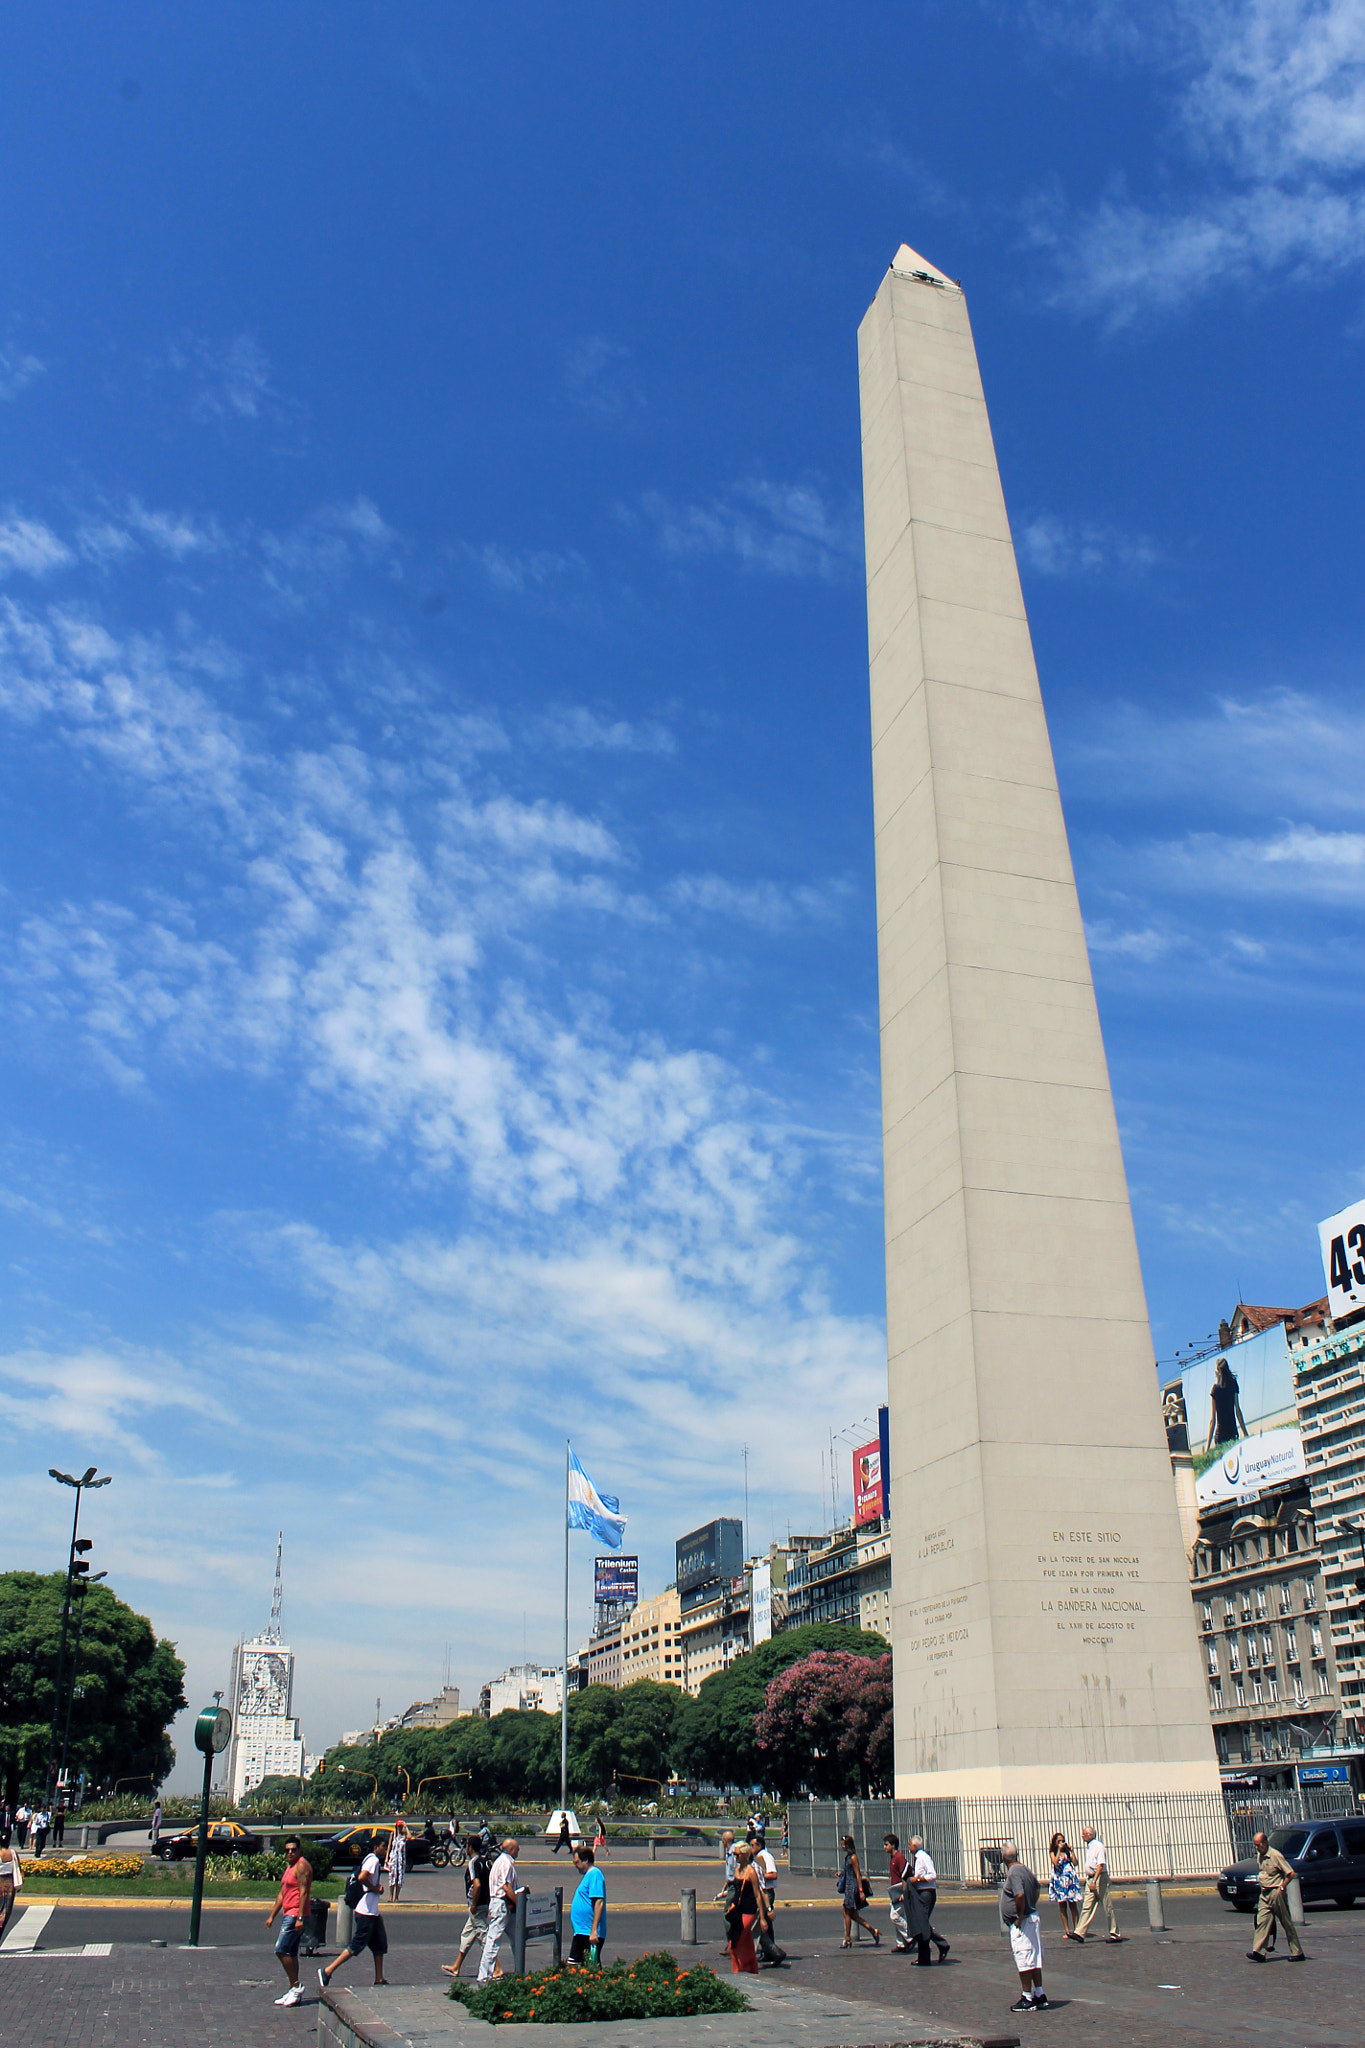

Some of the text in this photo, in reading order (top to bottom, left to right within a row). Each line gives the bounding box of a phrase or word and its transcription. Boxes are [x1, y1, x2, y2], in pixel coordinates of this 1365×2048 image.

[1053, 1532, 1121, 1543] EN ESTE SITIO
[596, 1560, 637, 1568] Trilenium
[1041, 1601, 1146, 1612] LA BANDERA NACIONAL
